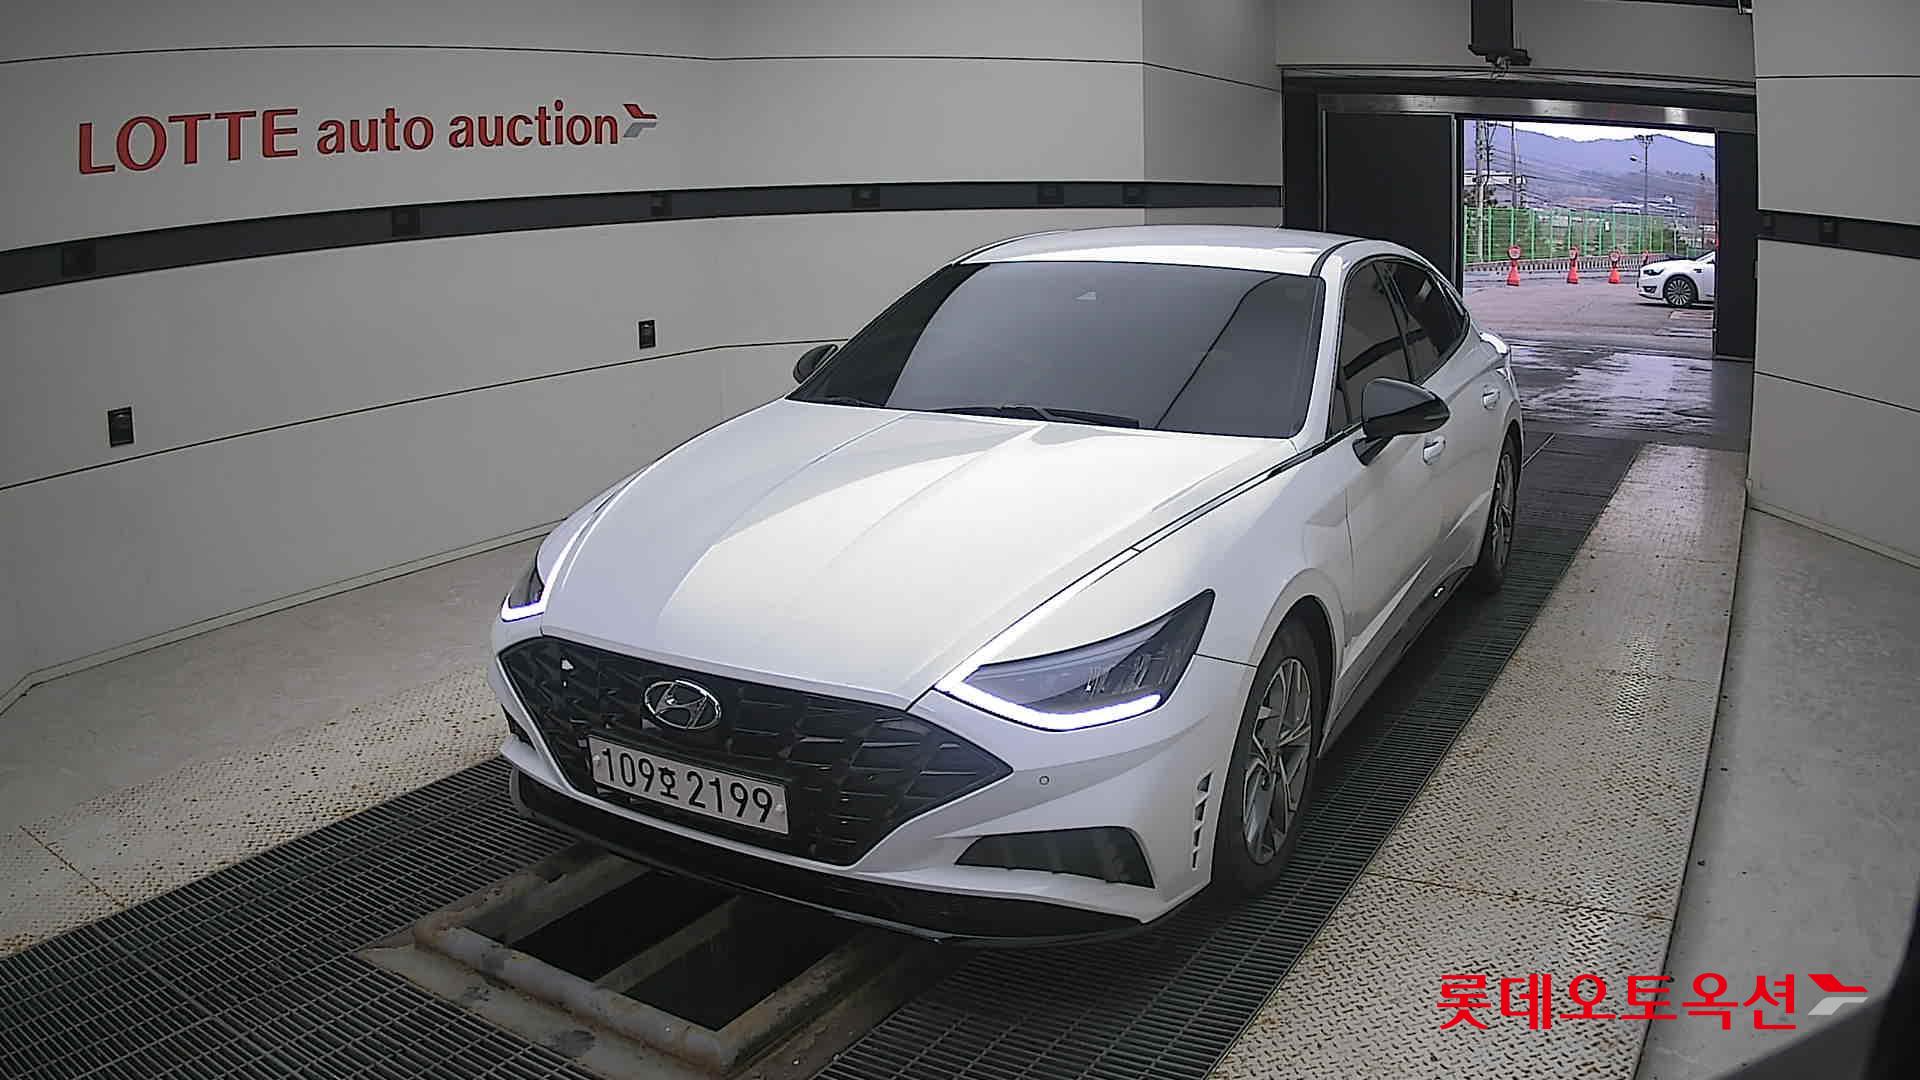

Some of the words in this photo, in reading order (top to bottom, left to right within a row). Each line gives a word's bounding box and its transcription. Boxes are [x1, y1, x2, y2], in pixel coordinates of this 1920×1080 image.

[79, 109, 298, 175] LOTTE
[316, 108, 434, 155] auto
[447, 100, 619, 148] auction
